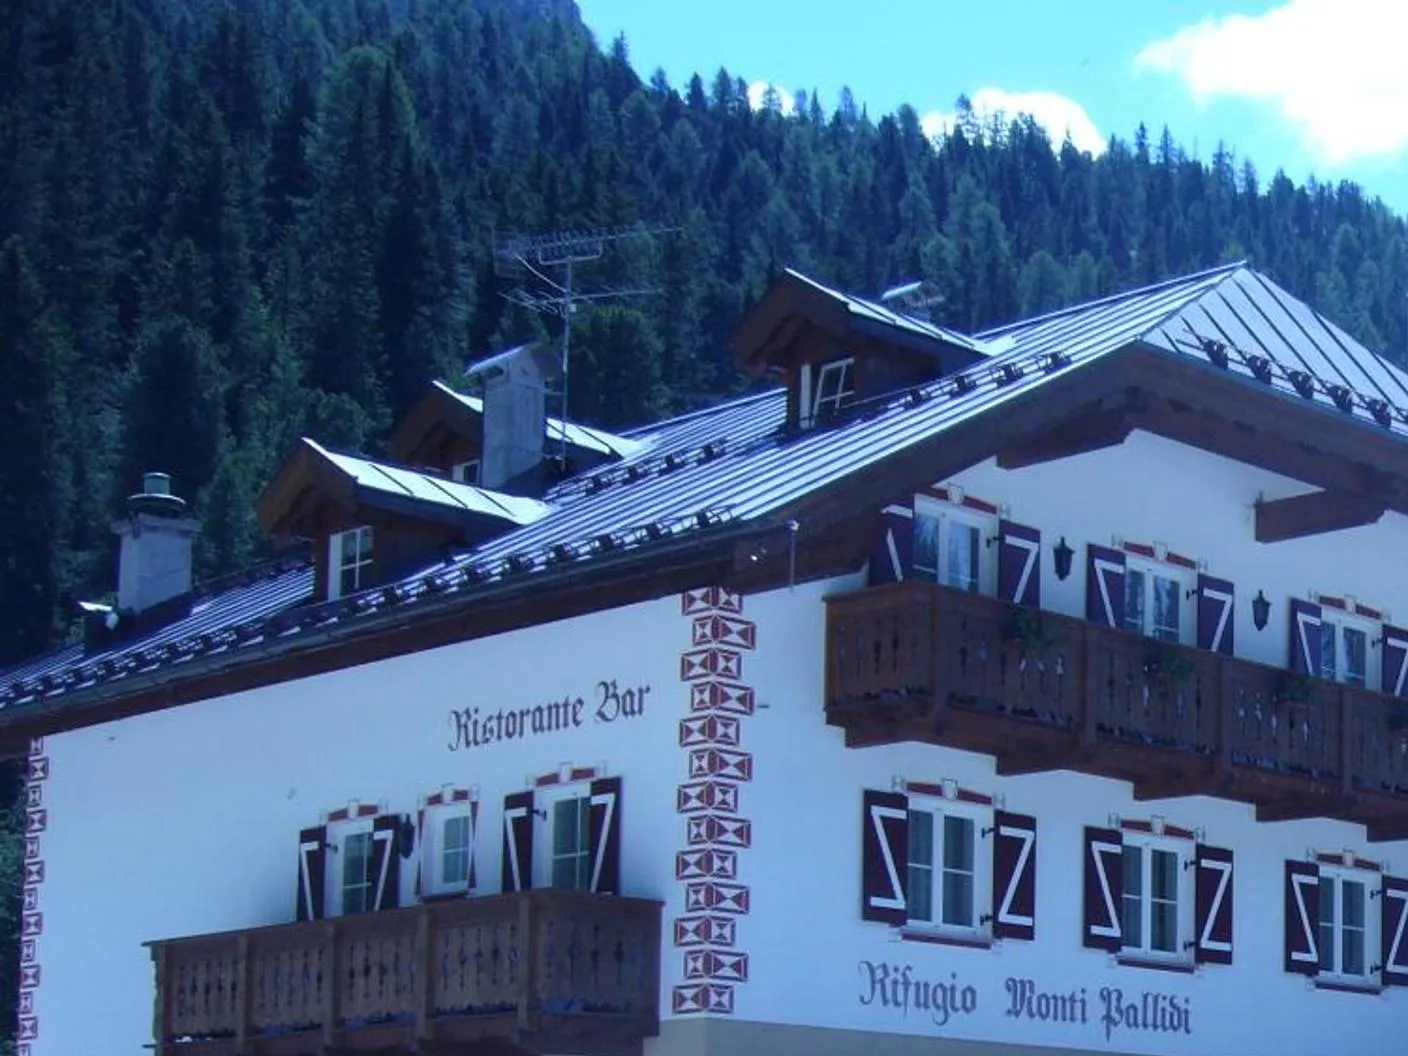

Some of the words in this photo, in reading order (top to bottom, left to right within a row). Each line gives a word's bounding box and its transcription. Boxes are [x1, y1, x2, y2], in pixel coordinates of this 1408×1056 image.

[448, 695, 584, 751] Ristorante
[595, 678, 651, 722] Bar
[857, 960, 977, 1026] Rifugio
[1005, 977, 1088, 1025] Monti
[1100, 986, 1192, 1042] Pallidi
